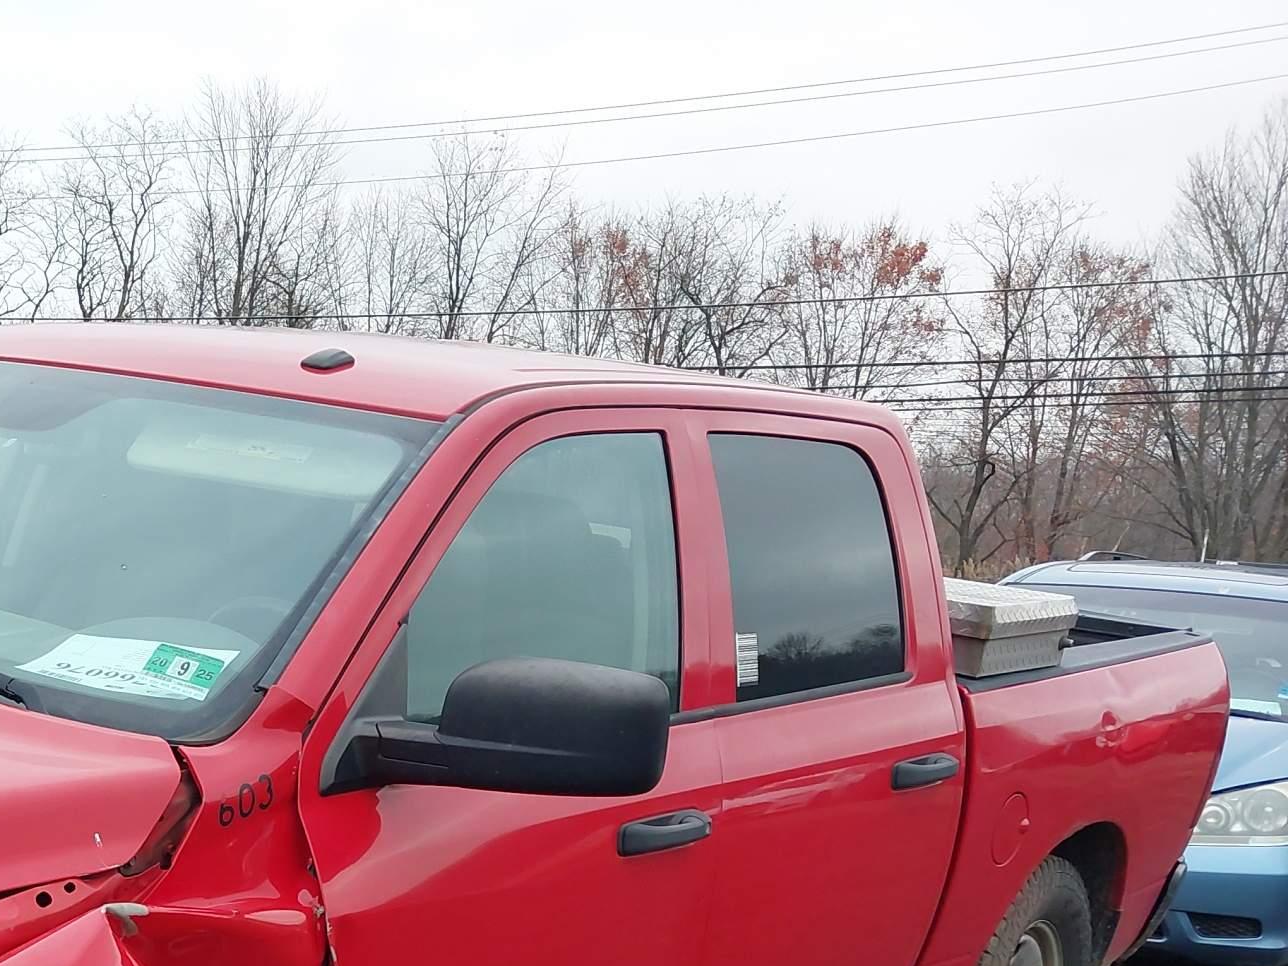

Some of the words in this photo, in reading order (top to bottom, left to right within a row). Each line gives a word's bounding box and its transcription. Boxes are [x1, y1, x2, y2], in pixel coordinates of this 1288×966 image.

[151, 656, 169, 668] 20
[177, 661, 191, 676] 9
[196, 669, 215, 681] 25
[218, 773, 274, 827] 603
